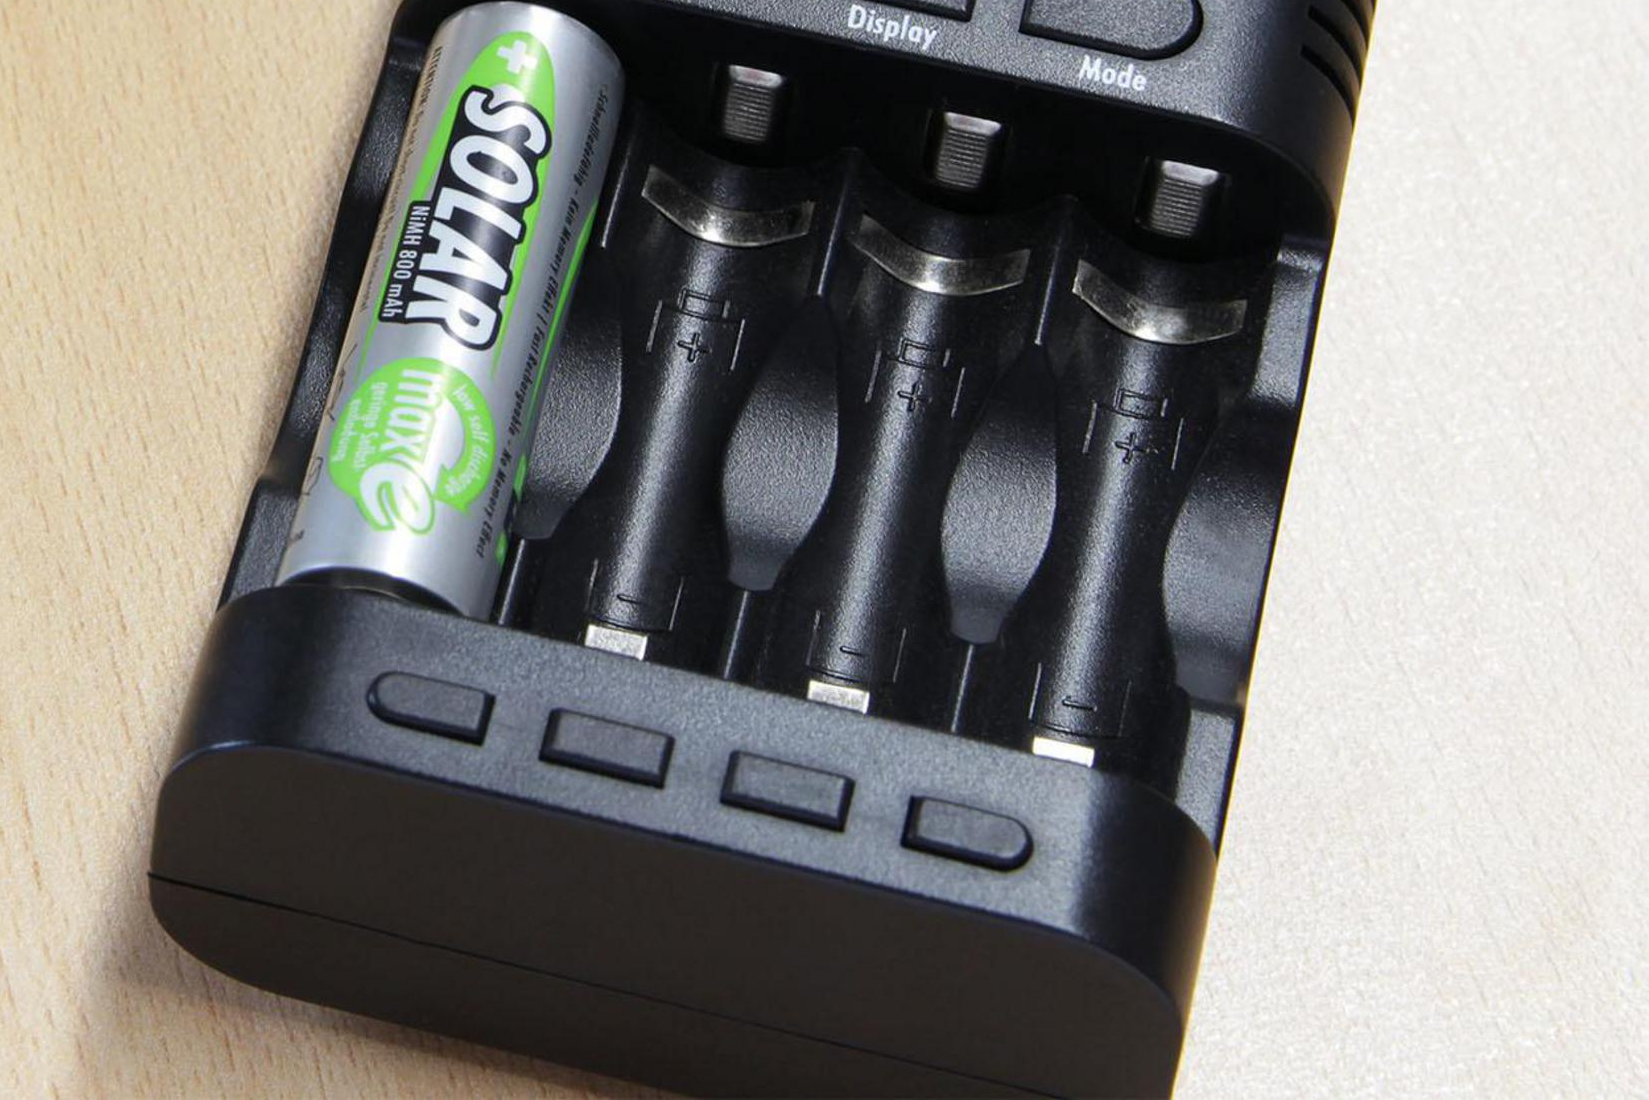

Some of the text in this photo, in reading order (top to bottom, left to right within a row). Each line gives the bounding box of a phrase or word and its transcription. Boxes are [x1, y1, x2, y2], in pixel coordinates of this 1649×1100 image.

[847, 4, 939, 49] Display
[1079, 54, 1147, 91] Mode
[403, 205, 430, 246] NiMH
[405, 88, 546, 346] SOLAR
[393, 250, 417, 279] 800
[548, 225, 572, 276] Memory
[382, 284, 404, 318] mAh
[453, 383, 475, 411] low
[469, 415, 490, 442] self
[483, 466, 507, 519] Memory
